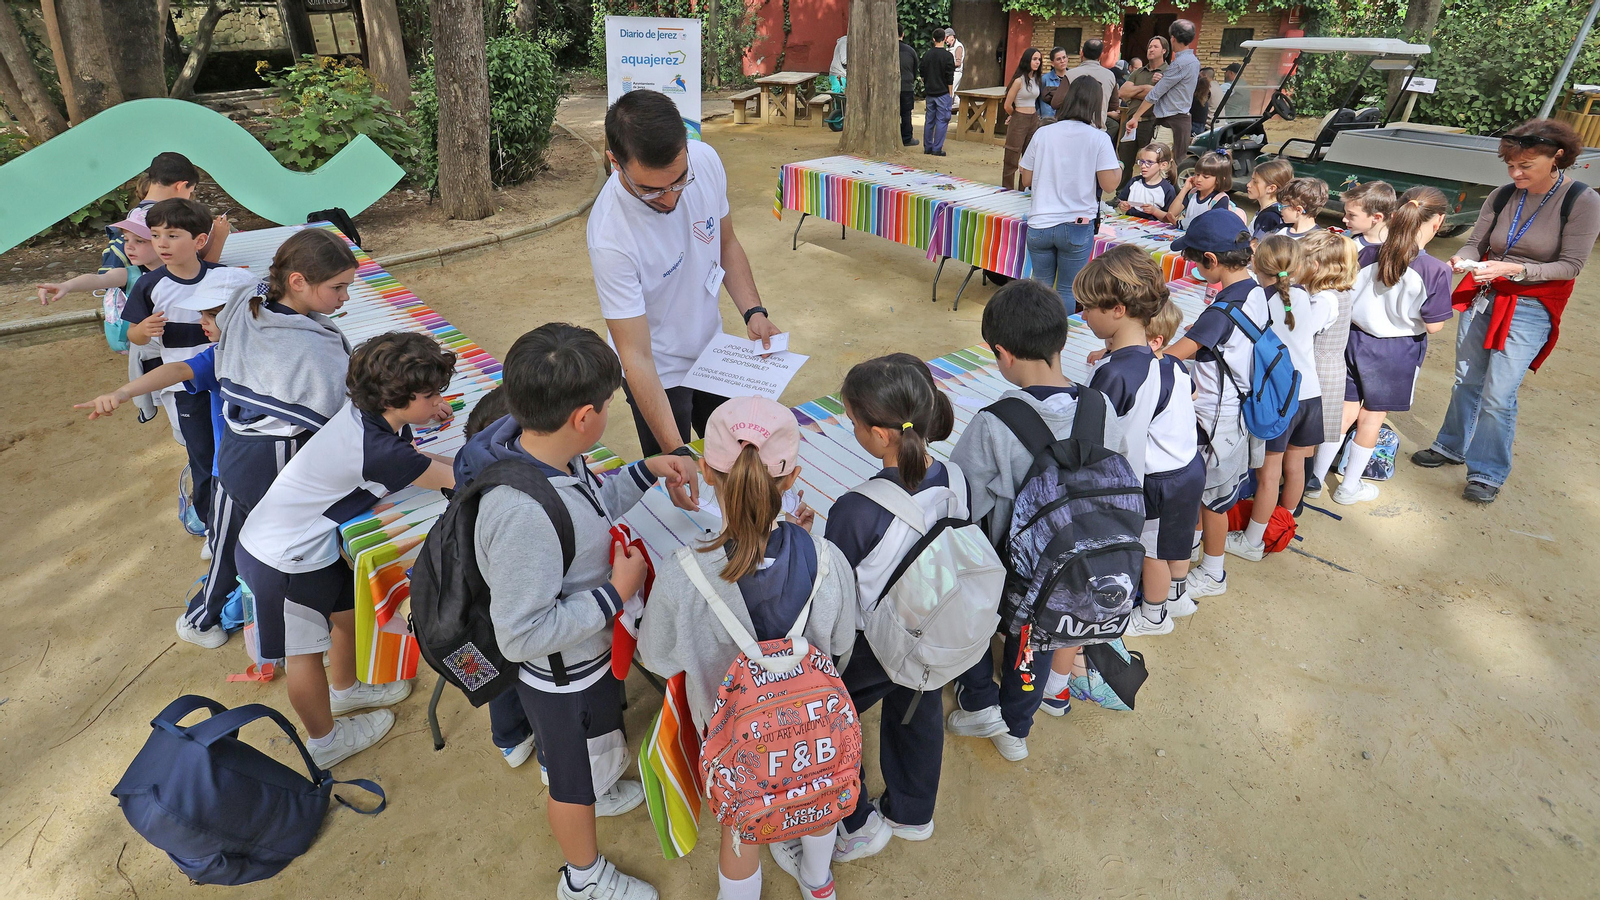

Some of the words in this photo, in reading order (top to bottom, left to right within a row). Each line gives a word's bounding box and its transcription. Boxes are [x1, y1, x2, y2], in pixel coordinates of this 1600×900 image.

[620, 28, 644, 39] Diario
[645, 29, 656, 39] de
[657, 30, 677, 41] Jerez
[621, 54, 679, 67] aquajerez
[724, 344, 741, 352] ¿POR
[712, 348, 760, 363] CONSUMIDORA
[769, 361, 789, 370] AGUA
[721, 357, 770, 372] RESPONSABLE?
[692, 371, 710, 379] LLUVIA
[724, 378, 741, 387] REGAR
[751, 385, 776, 395] PLANTAS
[698, 366, 718, 375] PORQUE
[719, 371, 739, 379] RECOJO
[746, 377, 761, 385] AGUA
[730, 421, 747, 433] TIO
[748, 422, 771, 439] PEPE
[777, 727, 792, 740] ARE
[768, 749, 788, 778] F
[791, 740, 812, 773] &
[815, 737, 837, 765] B
[781, 802, 833, 831] INSIDE
[784, 804, 819, 820] LOOK
